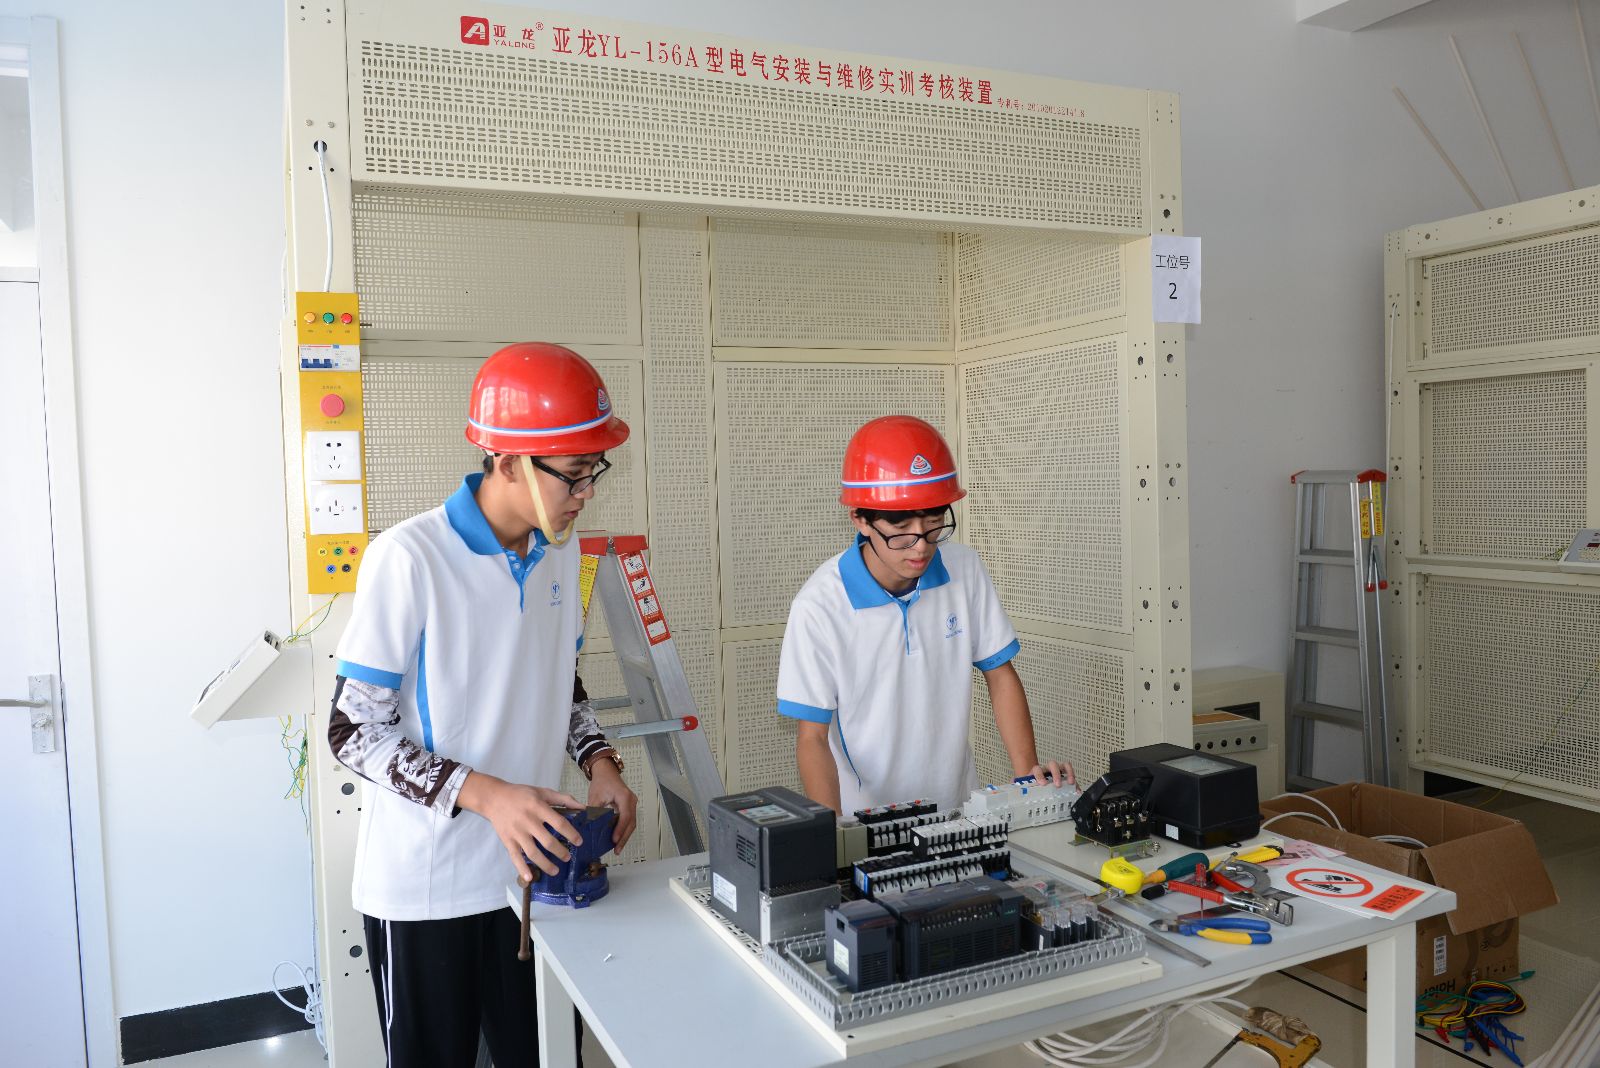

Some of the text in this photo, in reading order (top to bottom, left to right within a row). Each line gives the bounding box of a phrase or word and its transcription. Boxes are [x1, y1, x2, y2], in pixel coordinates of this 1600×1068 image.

[493, 38, 536, 50] YALONG
[1155, 254, 1191, 270] 工位号
[1168, 282, 1178, 300] 2
